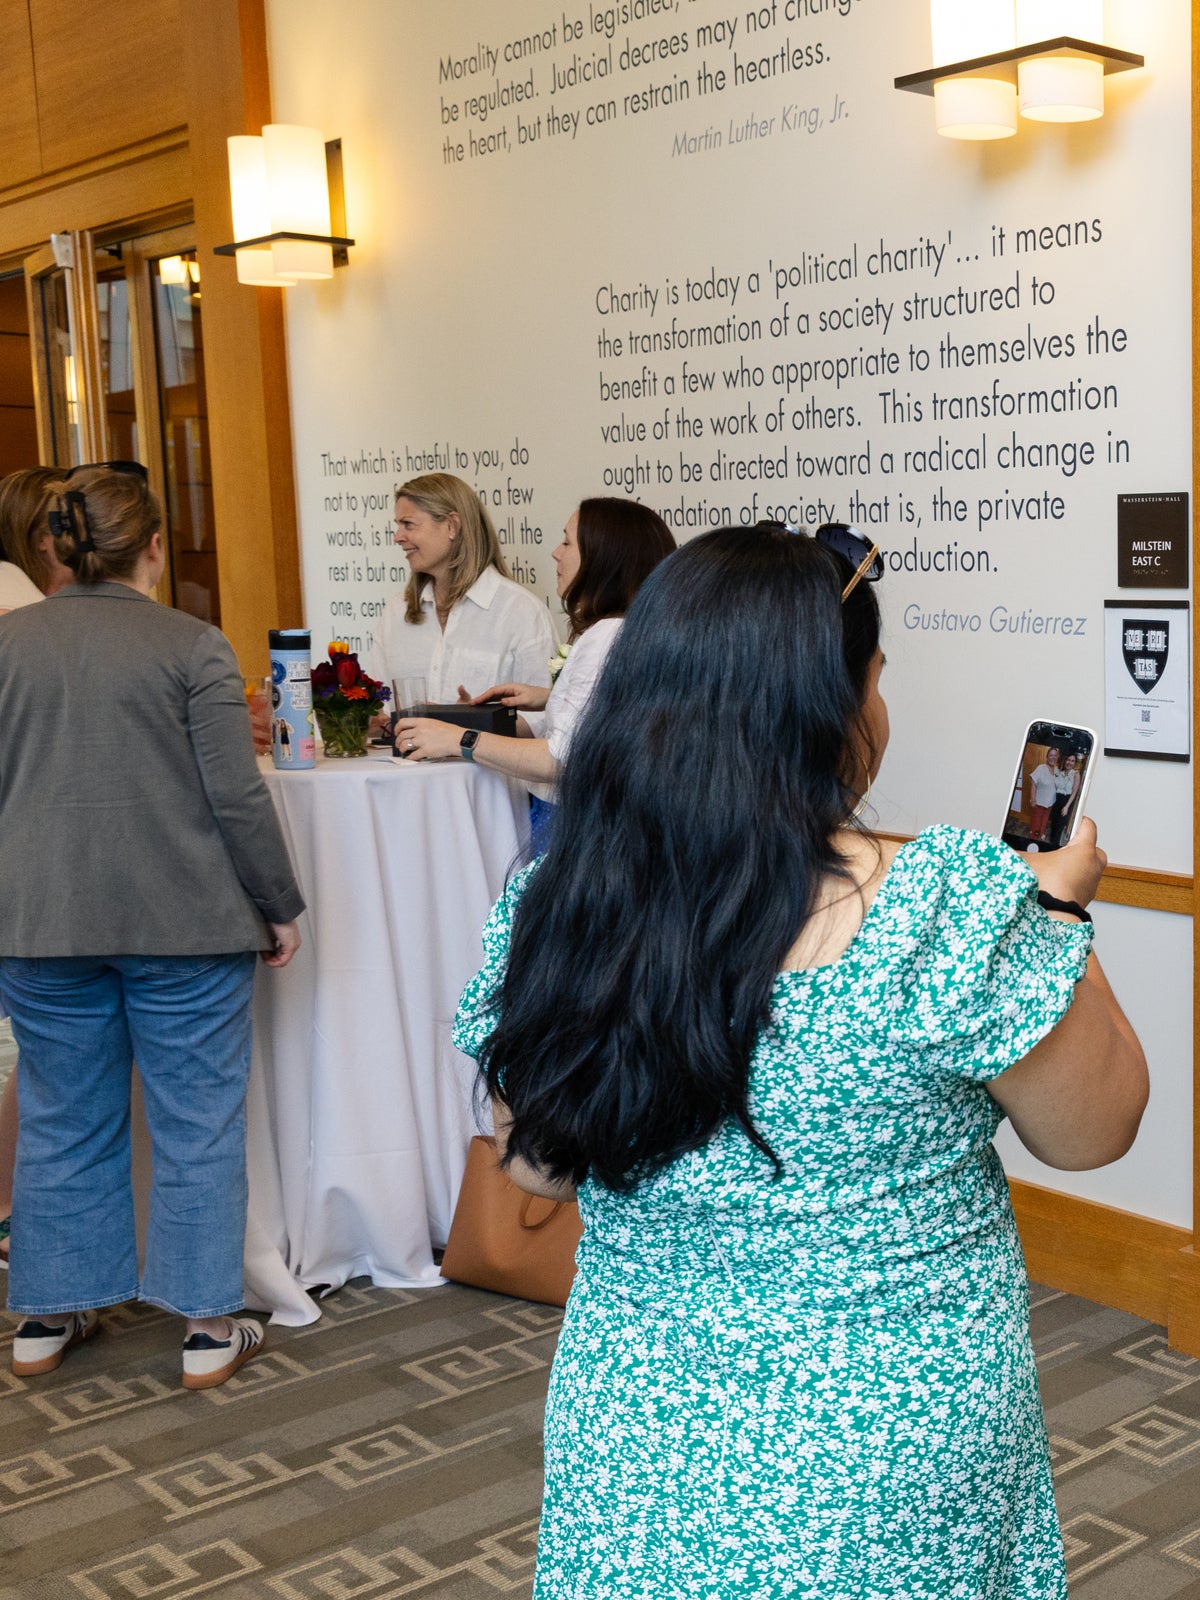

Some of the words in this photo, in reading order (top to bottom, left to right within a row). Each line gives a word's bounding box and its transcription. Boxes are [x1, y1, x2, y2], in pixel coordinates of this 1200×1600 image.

[439, 43, 498, 84] Morality
[504, 23, 557, 62] cannot
[563, 13, 583, 43] be
[441, 96, 459, 124] be
[465, 69, 539, 122] regulated.
[550, 43, 612, 95] Judicial
[619, 32, 688, 71] decrees
[697, 17, 738, 50] may
[746, 0, 777, 33] not
[443, 136, 464, 164] the
[469, 126, 511, 158] heart,
[517, 115, 541, 144] but
[547, 105, 580, 139] they
[586, 101, 616, 126] can
[624, 74, 689, 116] restrain
[697, 61, 726, 96] the
[734, 37, 830, 86] heartless.
[672, 126, 721, 157] Martin
[729, 113, 775, 144] Luther
[782, 105, 823, 133] King,
[830, 94, 848, 123] Jr.
[596, 283, 659, 318] Charity
[666, 278, 679, 305] is
[686, 266, 740, 306] today
[748, 273, 759, 293] a
[769, 243, 857, 300] 'political
[992, 225, 1005, 257] it
[1016, 219, 1102, 253] means
[598, 328, 622, 358] the
[629, 315, 761, 354] transformation
[770, 302, 789, 338] of
[797, 314, 809, 334] a
[819, 297, 894, 335] society
[903, 270, 1020, 322] structured
[1031, 276, 1055, 306] to
[600, 366, 658, 401] benefit
[664, 376, 675, 395] a
[682, 361, 716, 393] few
[722, 355, 764, 389] who
[772, 347, 900, 394] appropriate
[909, 344, 930, 372] to
[939, 323, 1075, 368] themselves
[1086, 315, 1127, 355] the
[601, 412, 646, 443] value
[653, 408, 670, 440] of
[676, 407, 703, 438] the
[710, 401, 758, 436] work
[765, 398, 785, 432] of
[792, 395, 861, 430] others.
[879, 388, 923, 424] This
[932, 378, 1117, 420] transformation
[321, 452, 347, 476] That
[350, 448, 387, 474] which
[392, 451, 402, 472] is
[406, 442, 450, 471] hateful
[455, 448, 468, 469] to
[473, 450, 504, 475] you,
[510, 437, 529, 466] do
[603, 454, 651, 494] ought
[657, 459, 673, 483] to
[680, 451, 702, 482] be
[710, 445, 788, 481] directed
[796, 440, 870, 477] toward
[880, 453, 893, 474] a
[904, 433, 986, 472] radical
[997, 431, 1095, 477] change
[1107, 430, 1129, 463] in
[324, 493, 342, 511] not
[346, 493, 358, 511] to
[361, 494, 389, 518] your
[492, 489, 502, 506] a
[507, 477, 533, 505] few
[658, 495, 732, 527] ndation
[740, 492, 758, 525] of
[766, 496, 840, 525] society,
[849, 489, 890, 523] that
[899, 493, 921, 528] is,
[932, 486, 967, 521] the
[978, 489, 1065, 532] private
[326, 522, 366, 549] words,
[371, 525, 381, 546] is
[499, 517, 514, 544] all
[520, 516, 542, 544] the
[1132, 541, 1171, 551] MILSTEIN
[329, 563, 349, 581] rest
[353, 561, 362, 582] is
[366, 557, 385, 582] but
[390, 567, 405, 582] an
[512, 556, 537, 584] this
[882, 537, 998, 573] roduction.
[1132, 557, 1152, 566] EAST
[1154, 556, 1161, 566] C
[330, 601, 356, 620] one,
[904, 604, 981, 632] Gustavo
[990, 606, 1087, 635] Gutierrez
[1129, 634, 1138, 643] VE
[1139, 663, 1153, 672] TAS
